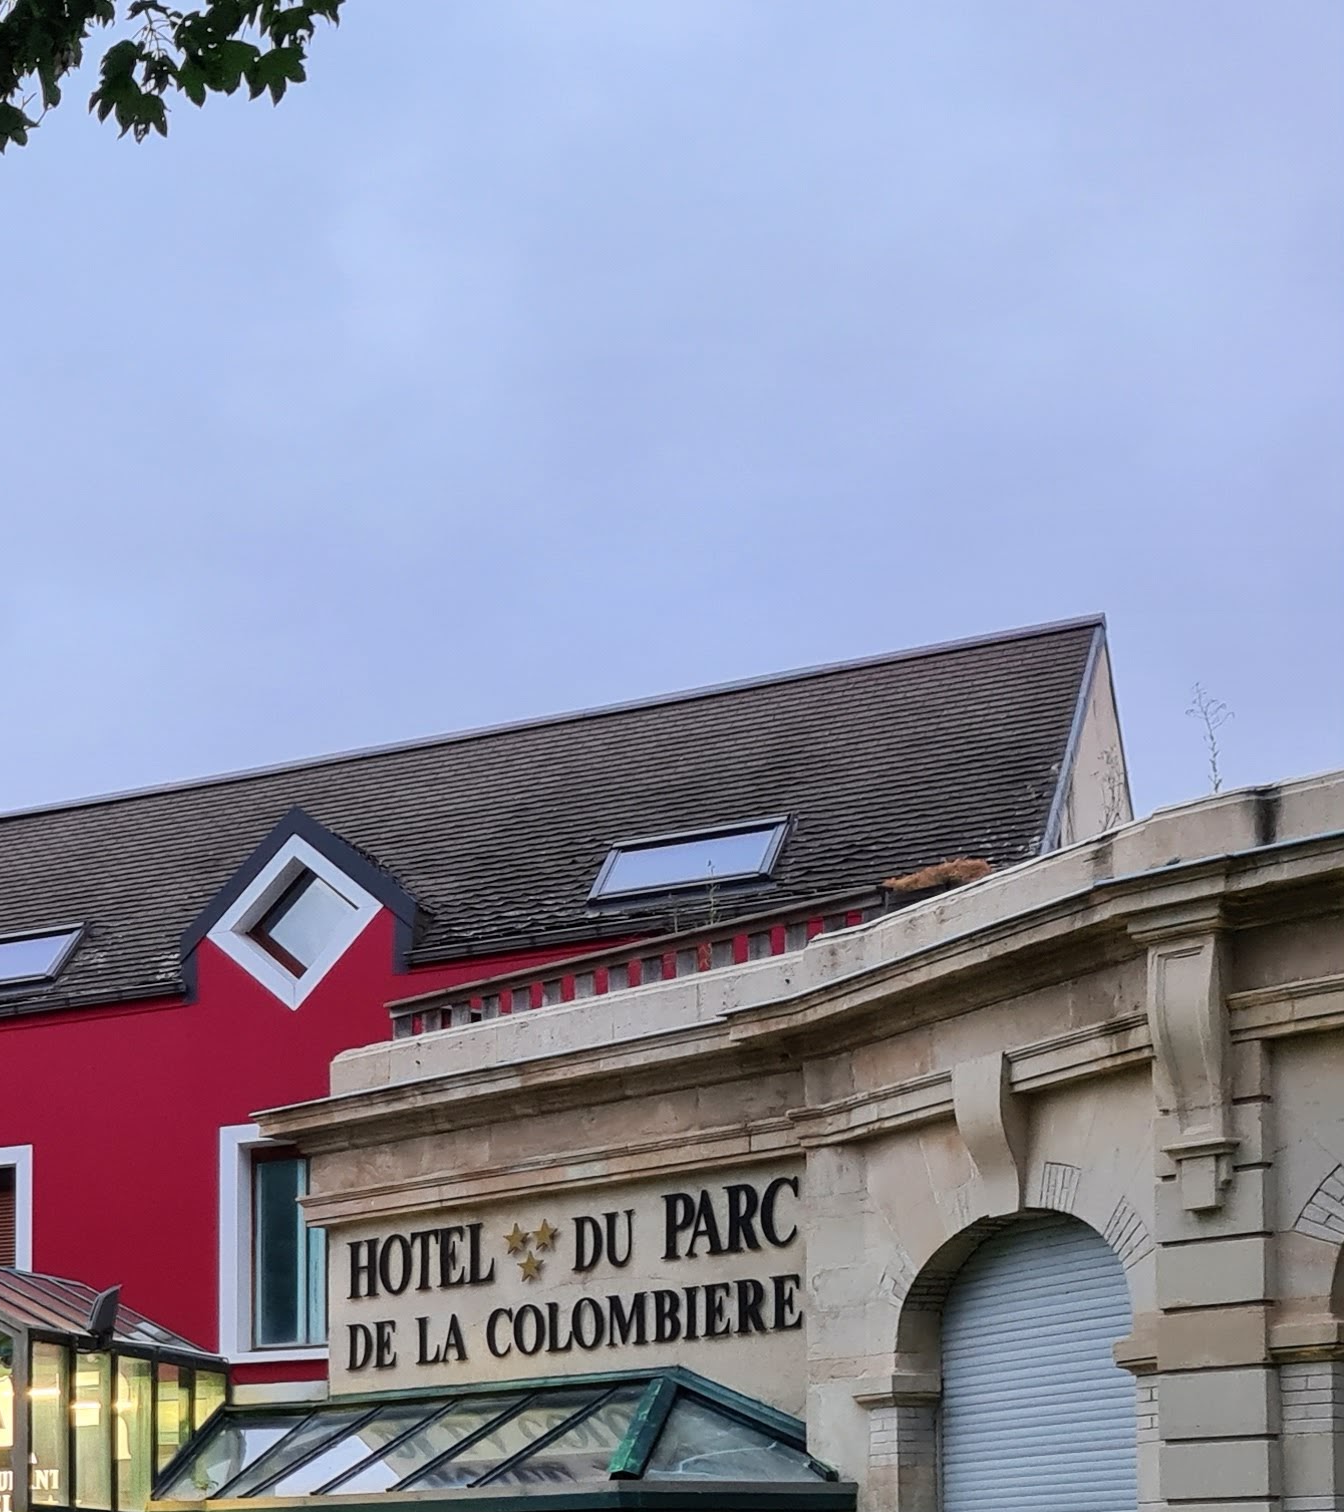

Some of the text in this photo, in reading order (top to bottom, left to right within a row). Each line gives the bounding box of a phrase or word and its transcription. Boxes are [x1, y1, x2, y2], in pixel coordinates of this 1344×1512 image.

[346, 1176, 800, 1301] HOTEL DU PARC
[346, 1273, 804, 1372] DE LA COLOMBIERE
